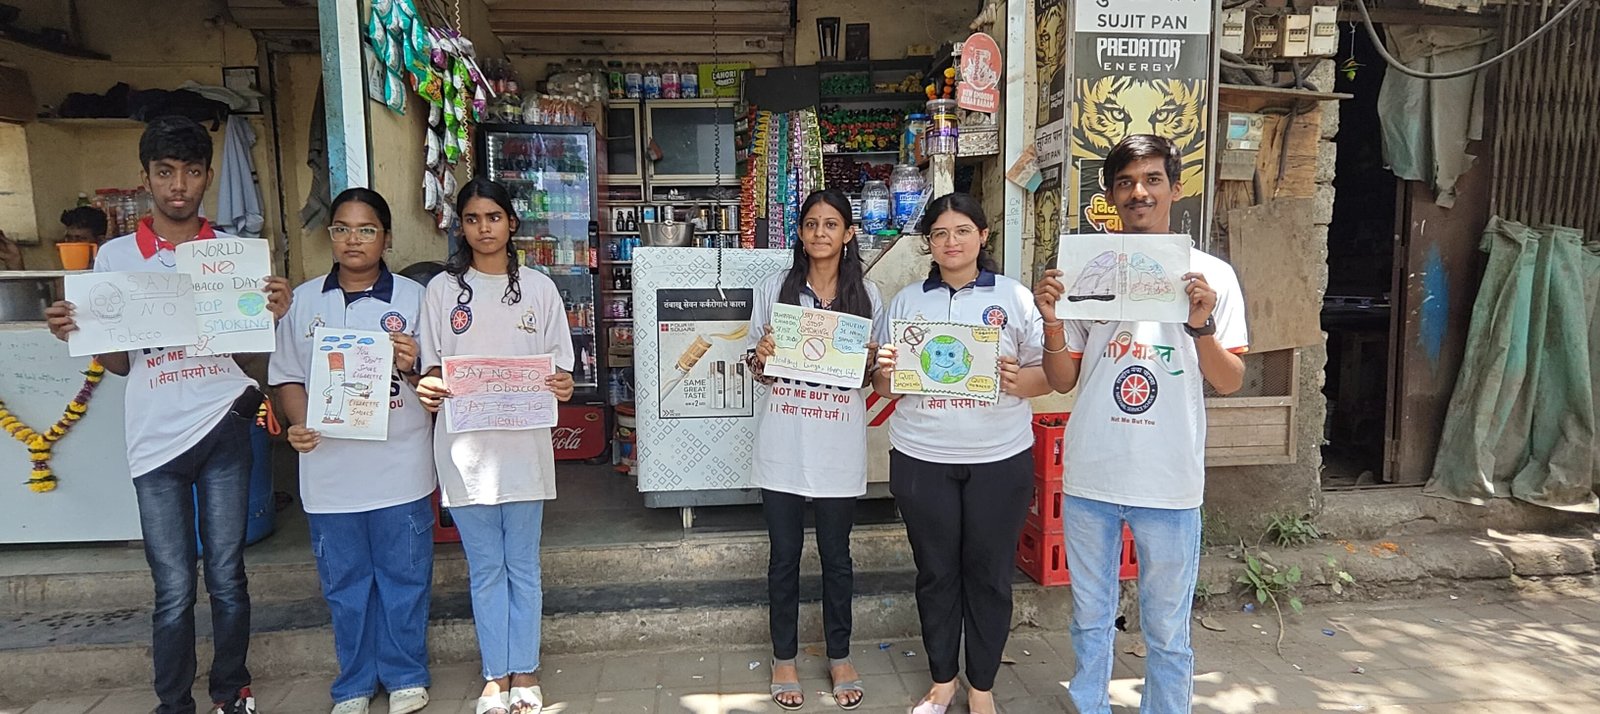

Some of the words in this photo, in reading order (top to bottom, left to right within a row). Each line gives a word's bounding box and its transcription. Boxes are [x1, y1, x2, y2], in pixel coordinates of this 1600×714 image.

[1097, 14, 1145, 28] SUJIT
[1151, 15, 1187, 29] PAN
[1096, 38, 1180, 69] PREDATOR
[1103, 62, 1174, 72] ENERGY
[192, 241, 244, 258] WORLD
[126, 274, 171, 292] SAY
[232, 276, 261, 289] DAY
[141, 302, 177, 316] NO
[195, 299, 222, 312] TOP
[201, 318, 271, 333] SMOKING
[167, 350, 184, 361] ME
[454, 366, 484, 379] SAY
[491, 368, 512, 380] NO
[486, 380, 540, 393] Tobacco
[772, 386, 791, 396] NOT
[793, 388, 807, 398] ME
[809, 390, 829, 401] BUT
[832, 393, 850, 404] YOU
[389, 399, 404, 409] OU
[456, 400, 486, 413] SAY
[927, 397, 946, 409] सेवा
[781, 402, 798, 415] सेवा
[801, 406, 822, 419] परमो
[824, 408, 839, 421] धर्म
